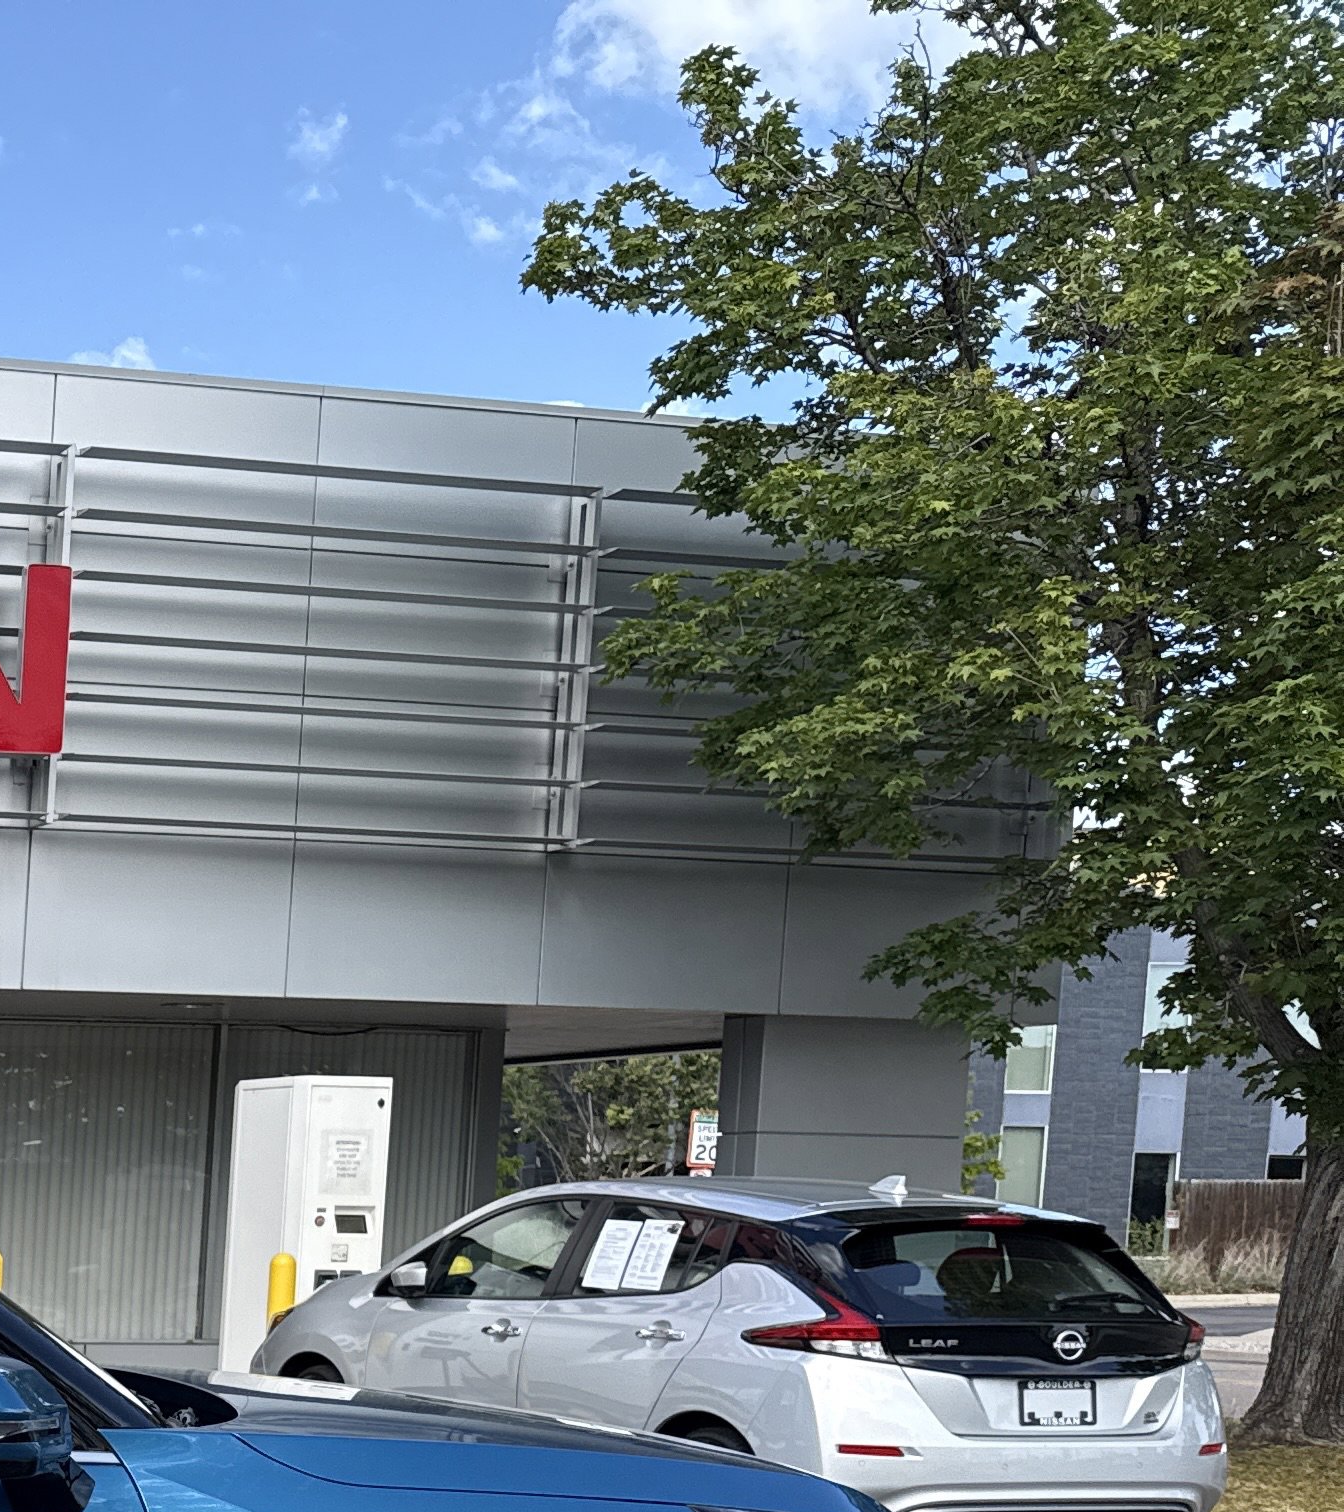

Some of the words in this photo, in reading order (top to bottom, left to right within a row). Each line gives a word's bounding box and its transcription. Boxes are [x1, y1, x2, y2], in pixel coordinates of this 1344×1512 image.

[697, 1125, 716, 1133] SPEE
[695, 1144, 717, 1161] 20
[909, 1339, 959, 1348] LEAF
[1038, 1381, 1080, 1389] BOULDER
[1040, 1417, 1080, 1426] NISSAN
